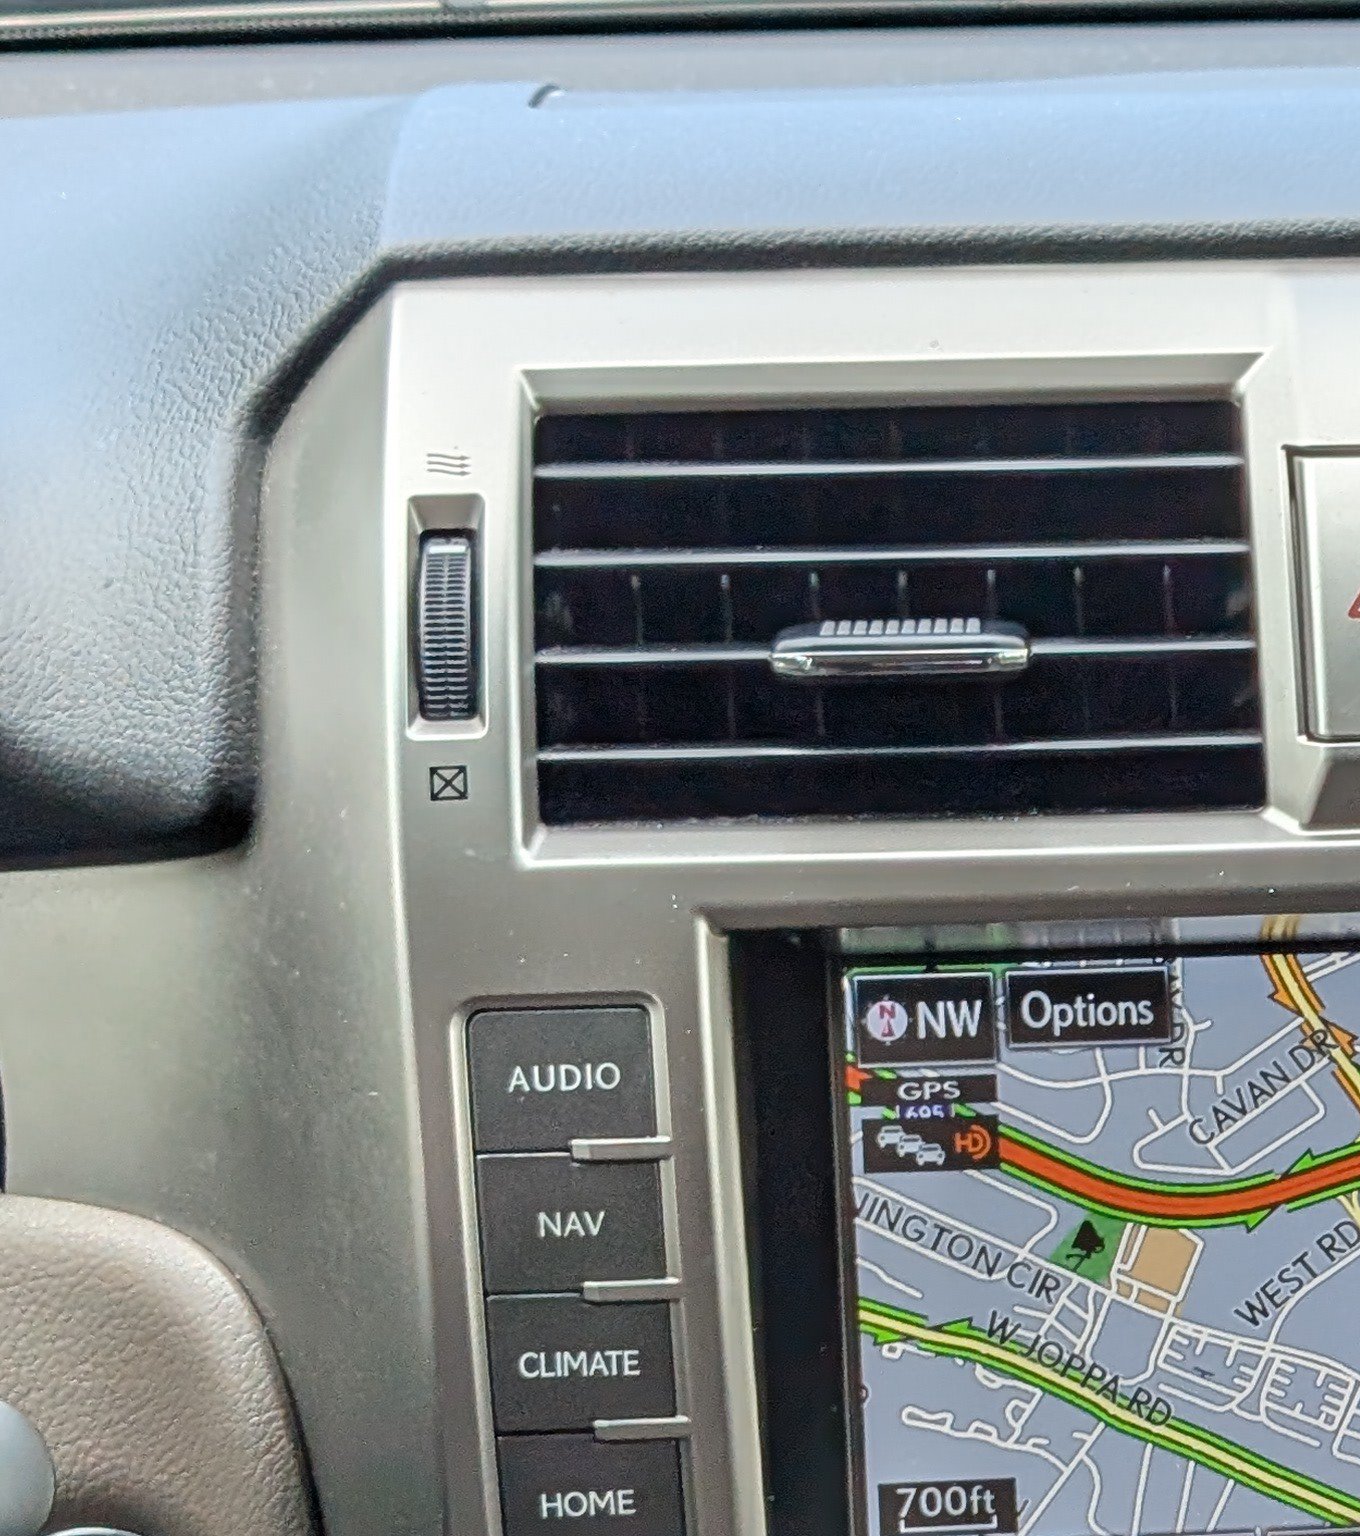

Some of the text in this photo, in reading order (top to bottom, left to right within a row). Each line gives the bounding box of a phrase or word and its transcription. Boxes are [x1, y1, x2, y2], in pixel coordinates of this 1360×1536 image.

[916, 999, 983, 1039] NW
[1020, 989, 1155, 1037] Options
[508, 1061, 622, 1093] AUDIO
[898, 1080, 962, 1101] GPS
[1188, 1029, 1340, 1145] CAVAN DR
[538, 1211, 606, 1238] NAV
[1006, 1260, 1061, 1304] CIR
[1233, 1251, 1319, 1327] WEST
[518, 1348, 642, 1380] CLIMATE
[987, 1309, 1172, 1426] W JOPPA RD
[539, 1489, 638, 1520] HOME
[895, 1486, 998, 1519] 700ft
